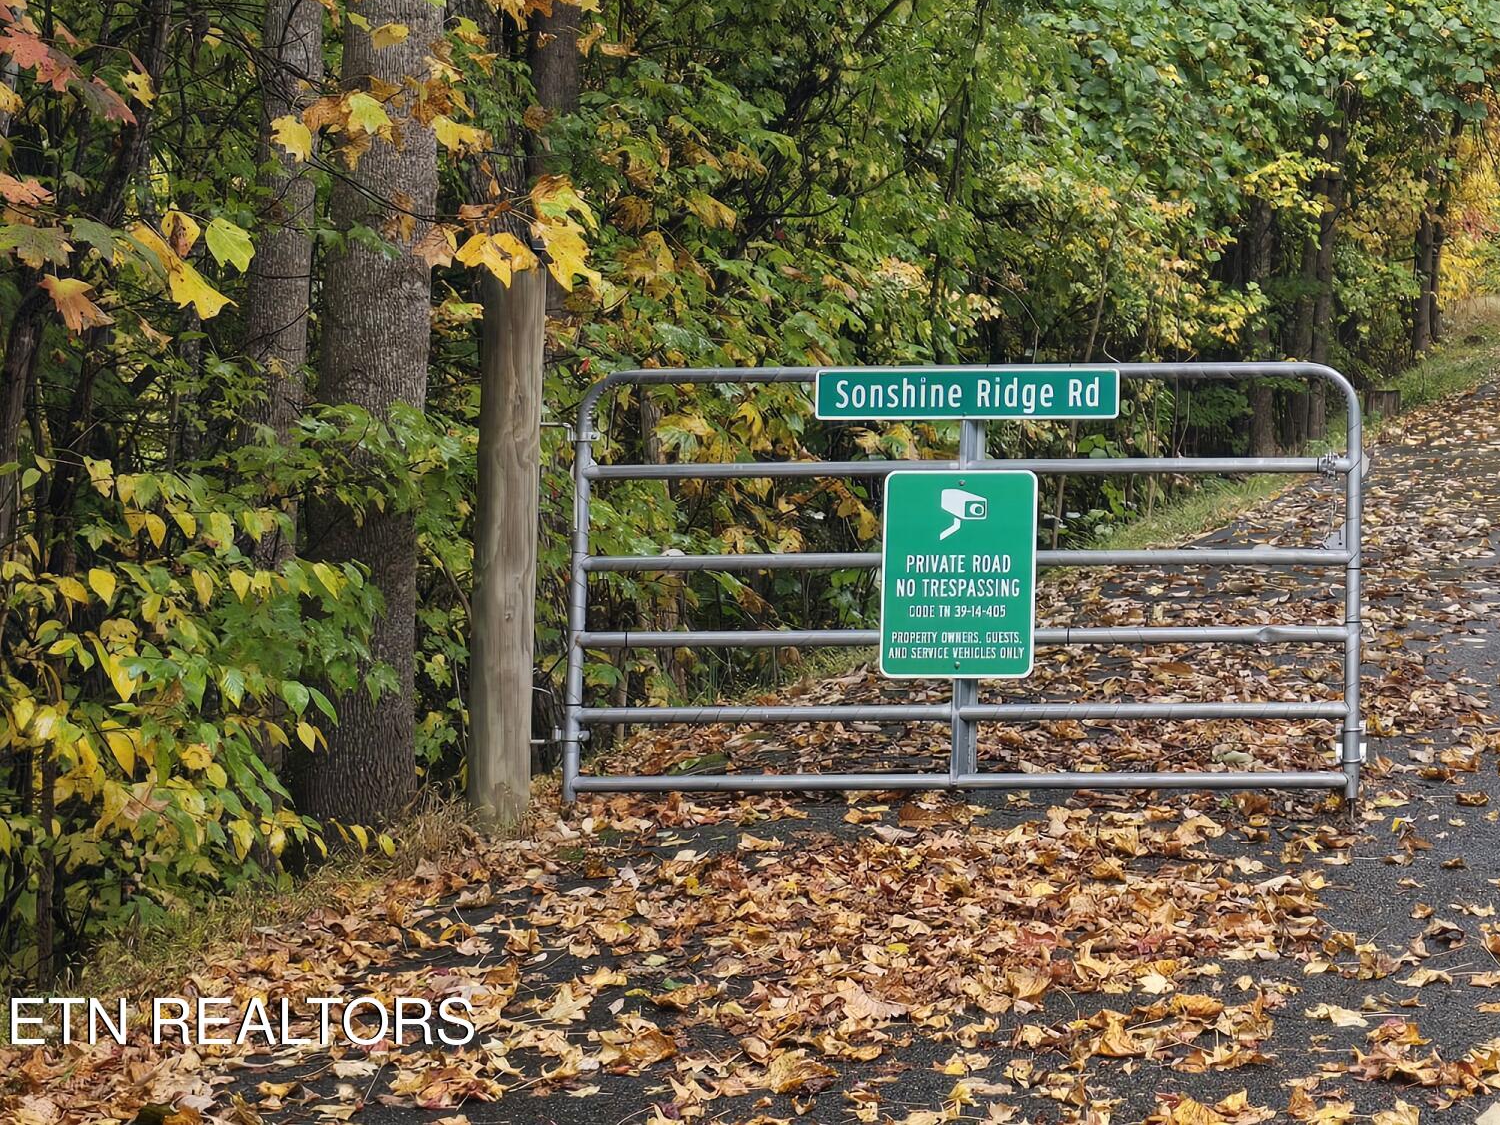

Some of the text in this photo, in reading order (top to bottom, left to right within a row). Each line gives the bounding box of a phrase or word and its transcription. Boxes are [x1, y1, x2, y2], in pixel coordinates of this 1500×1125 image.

[835, 376, 1100, 414] Sonshine Ridge Rd
[906, 554, 1011, 573] PRIVATE ROAD
[896, 578, 1020, 597] NO TRESPASSING
[909, 605, 1006, 618] CODE TN 39-14-405
[891, 631, 937, 644] PROPERTY
[888, 646, 1025, 659] AND SERVICE VEHICLES ONLY
